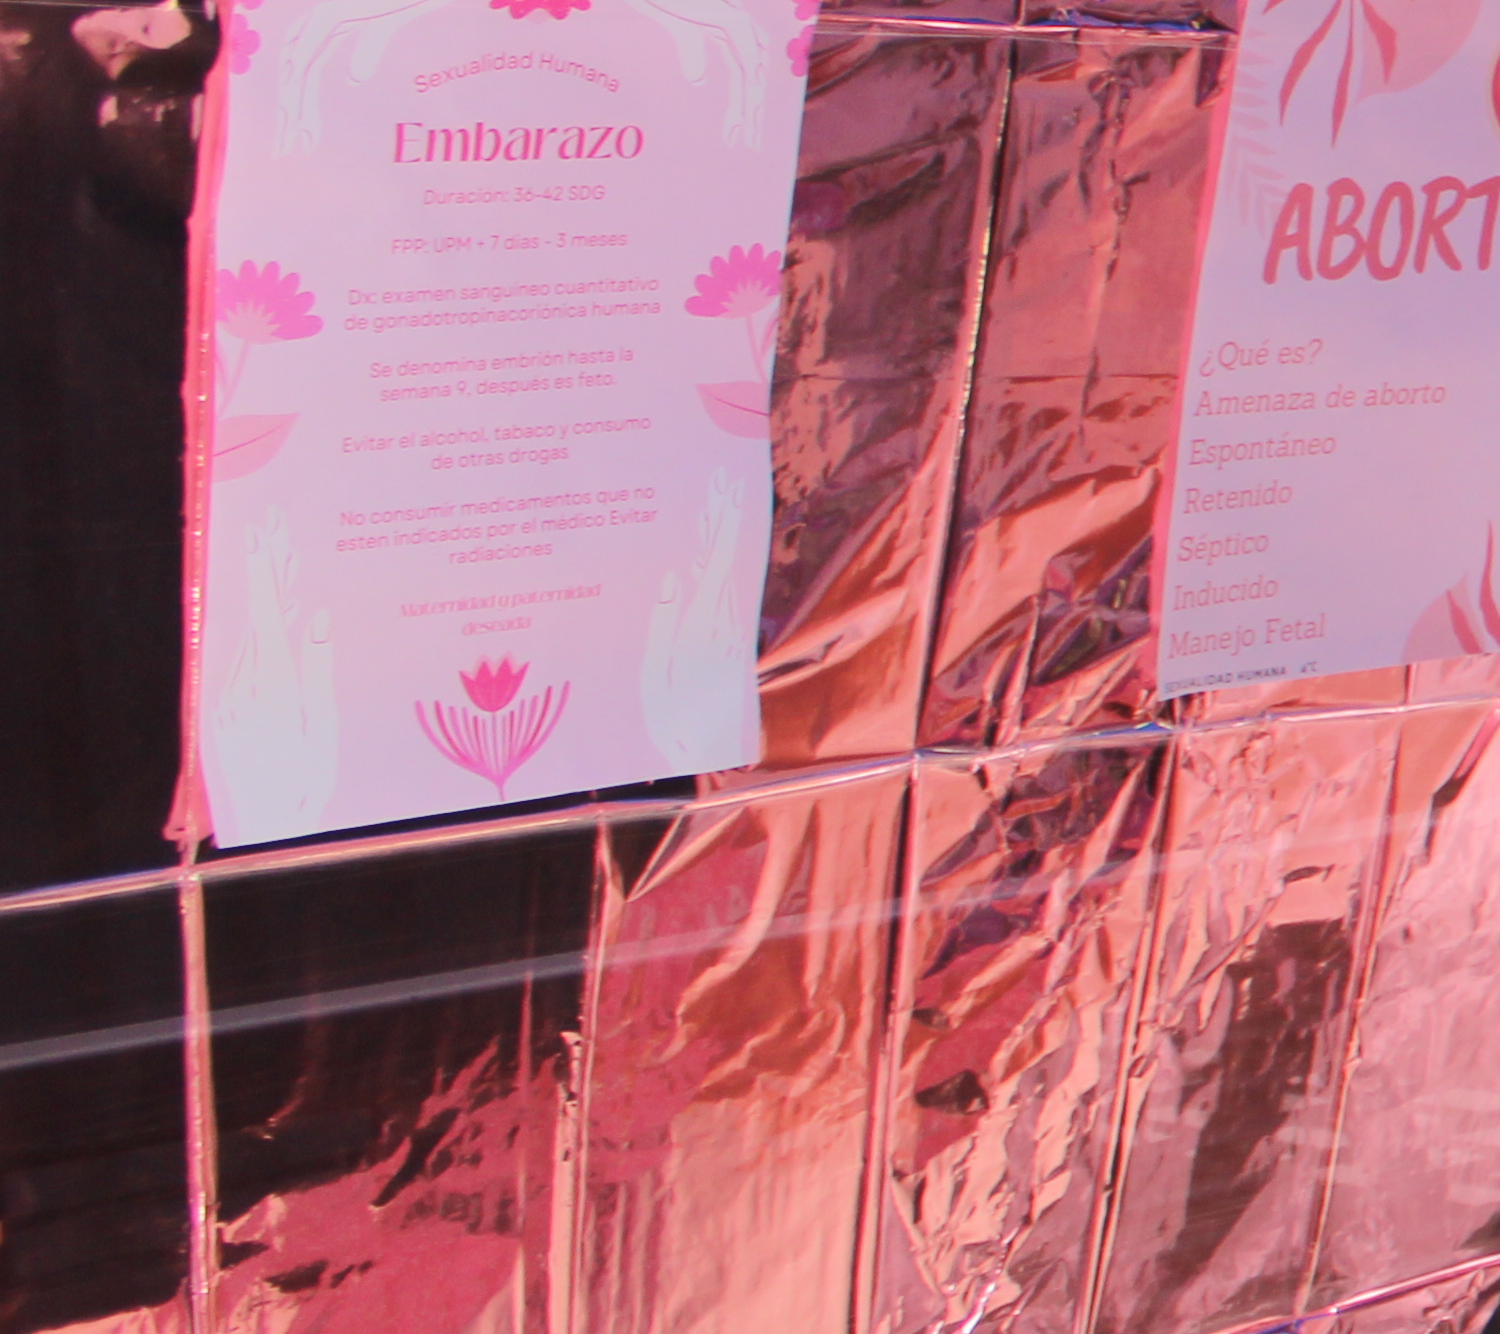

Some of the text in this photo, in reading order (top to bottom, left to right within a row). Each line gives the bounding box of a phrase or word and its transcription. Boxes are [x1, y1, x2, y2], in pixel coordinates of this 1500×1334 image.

[413, 51, 620, 93] Sexualidad Humana
[393, 122, 645, 164] Embarazo
[513, 186, 563, 202] 36-42
[568, 184, 606, 201] SDG
[490, 234, 500, 251] 7
[557, 232, 568, 248] 3
[571, 233, 628, 248] meses
[382, 286, 455, 304] examen
[555, 276, 659, 296] cuantitativo
[344, 315, 368, 331] de
[593, 300, 661, 317] humana
[370, 362, 393, 379] Se
[397, 356, 487, 378] denomina
[568, 348, 615, 366] hasta
[619, 346, 634, 362] la
[1200, 338, 1323, 378] ¿Qué es?
[380, 383, 451, 402] semana
[554, 375, 574, 390] es
[1194, 382, 1447, 417] Amenaza de aborto
[342, 434, 394, 454] Evitar
[399, 432, 415, 449] el
[494, 422, 555, 441] tabaco
[558, 423, 570, 440] y
[573, 417, 651, 436] consumo
[1189, 432, 1337, 470] Espontáneo
[431, 445, 569, 471] de otras drogas
[340, 485, 655, 527] No consumir medicamentos que no
[1183, 479, 1294, 515] Retenido
[394, 524, 482, 547] indicados
[486, 522, 517, 541] por
[521, 517, 537, 534] el
[609, 507, 658, 526] Evitar
[449, 541, 554, 565] radiaciones
[1177, 533, 1270, 566] Séptico
[1173, 574, 1281, 612] Inducido
[1167, 613, 1328, 660] Manejo Fetal
